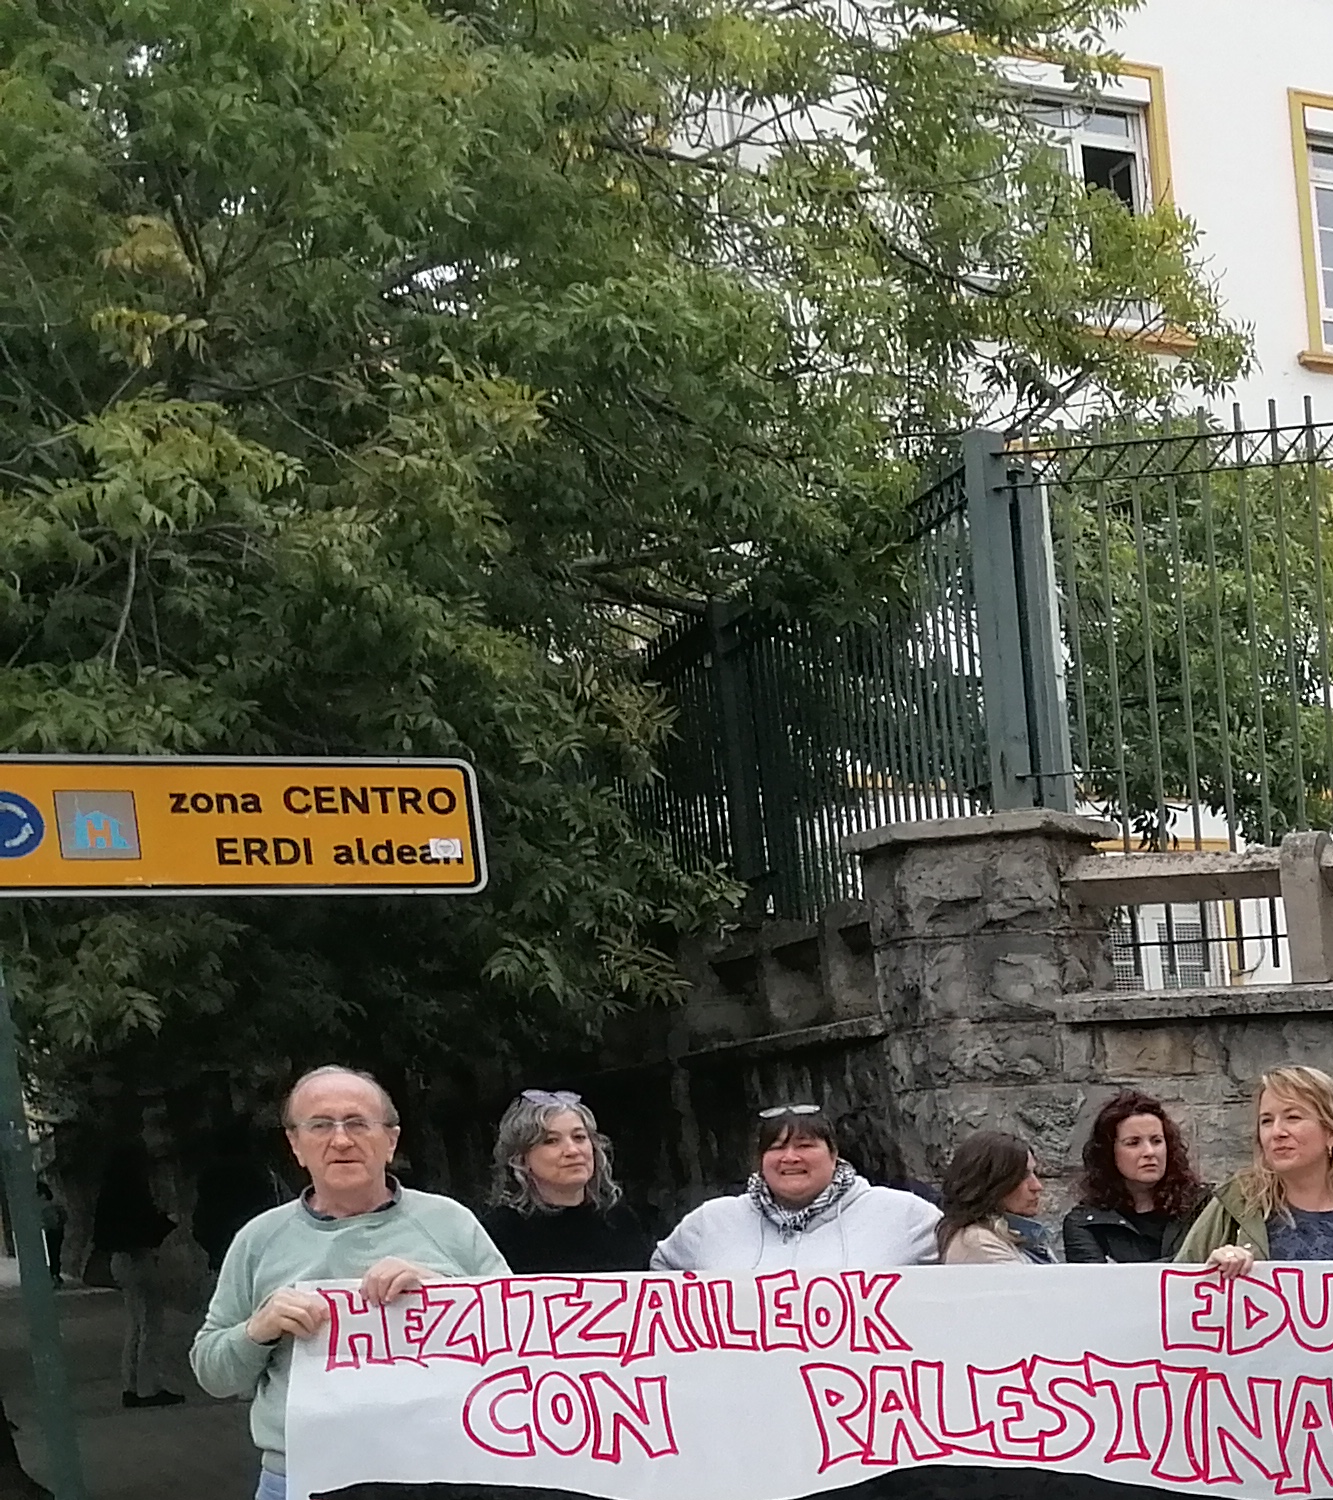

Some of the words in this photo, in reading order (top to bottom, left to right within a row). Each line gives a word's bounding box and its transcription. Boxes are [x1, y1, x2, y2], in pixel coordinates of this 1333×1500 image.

[169, 791, 262, 814] zona
[283, 786, 457, 815] CENTRO
[216, 838, 312, 865] ERDI
[463, 1365, 679, 1463] CON
